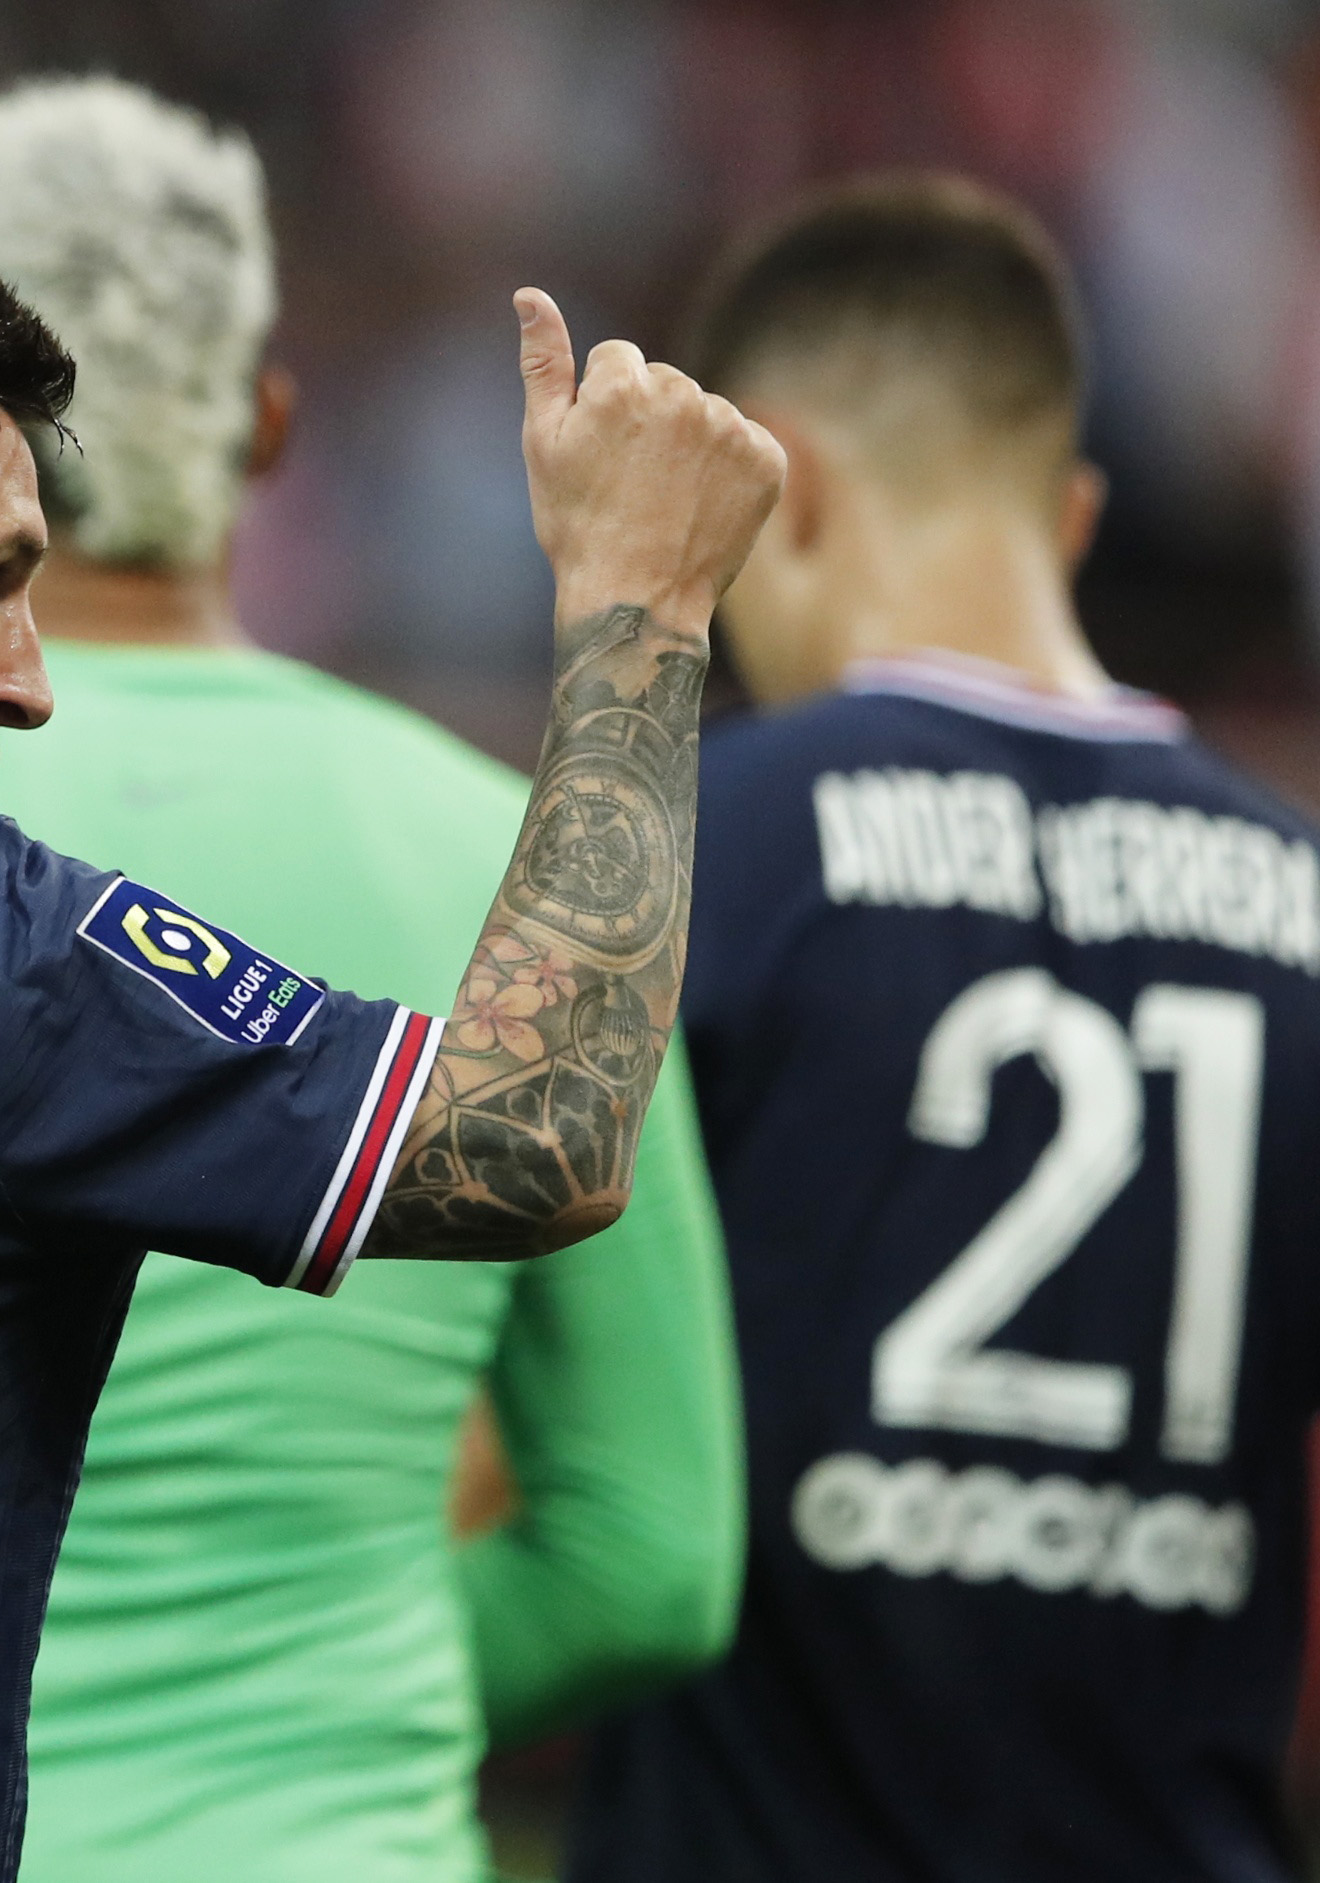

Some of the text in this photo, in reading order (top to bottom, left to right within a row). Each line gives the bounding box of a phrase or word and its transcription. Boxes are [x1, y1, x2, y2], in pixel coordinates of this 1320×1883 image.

[220, 965, 268, 1020] LIGUE
[240, 976, 301, 1043] Uber Eats
[870, 964, 1266, 1466] 21
